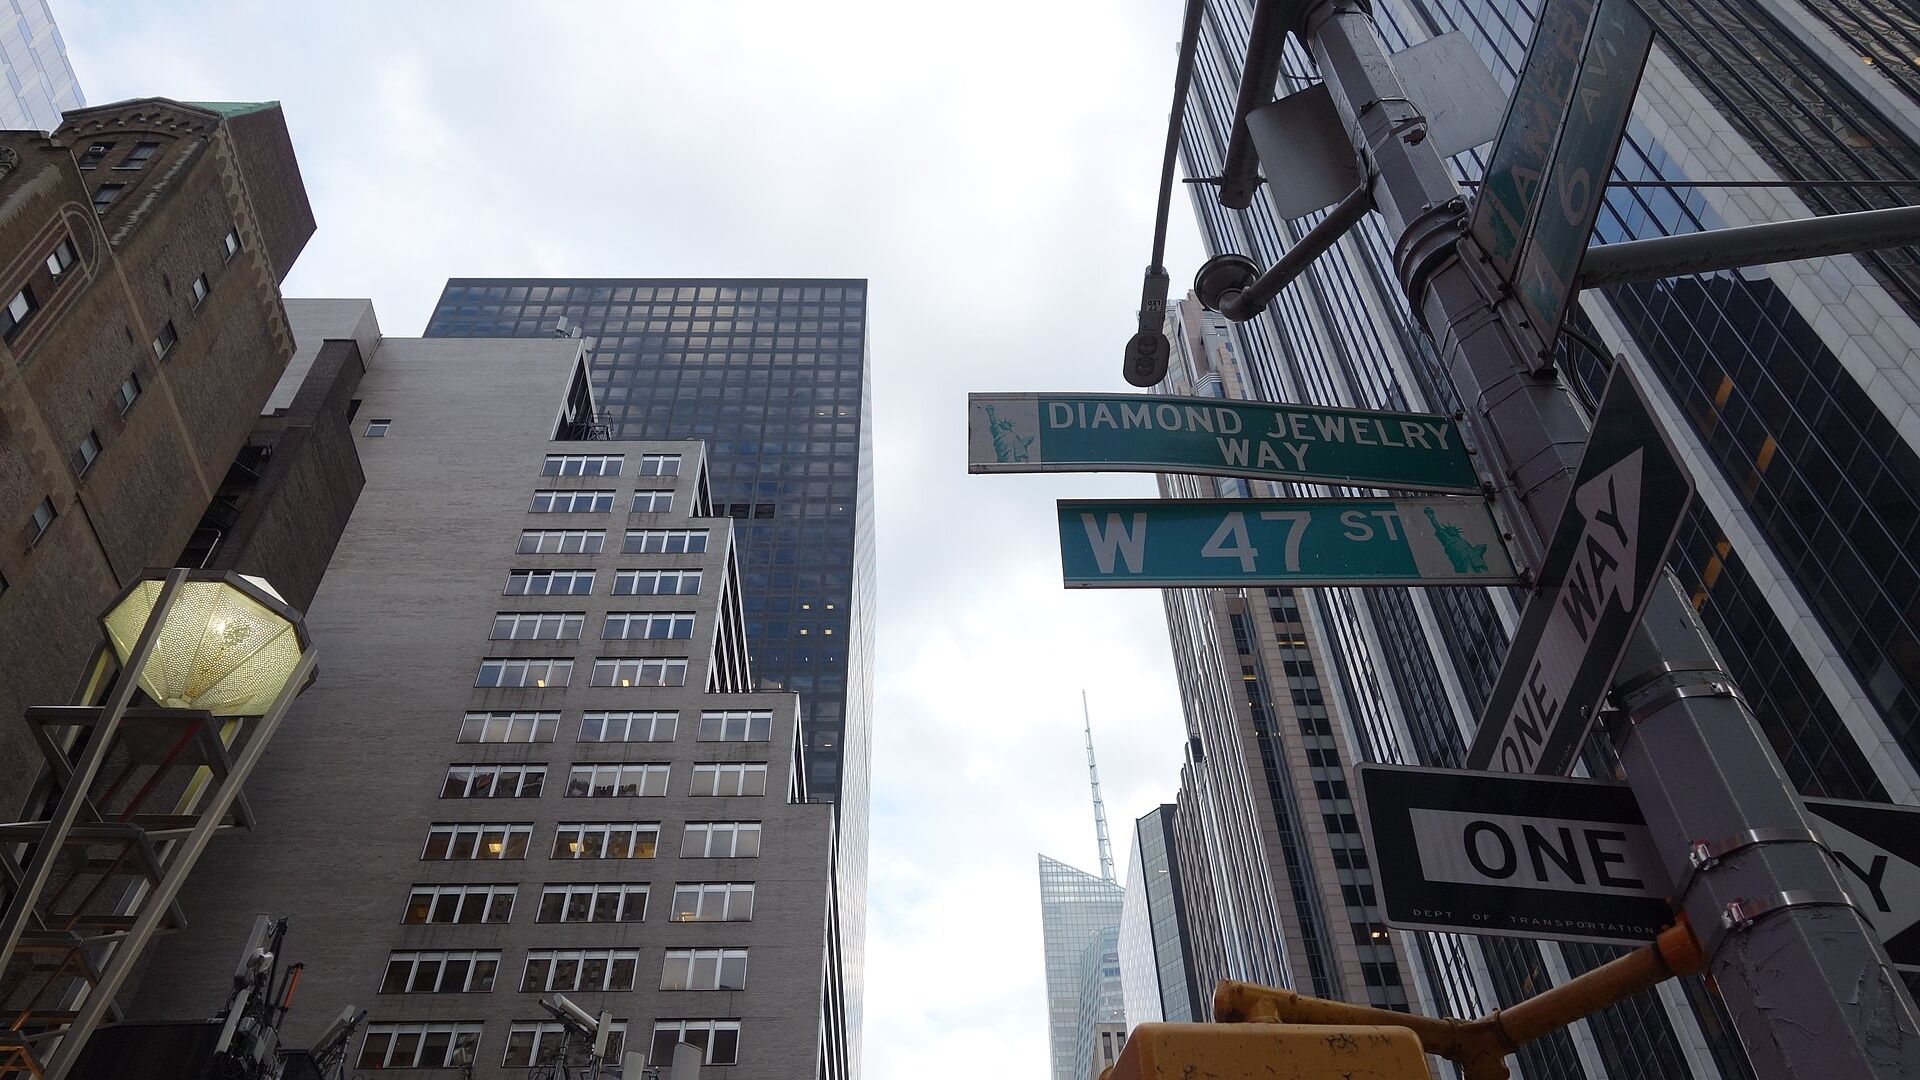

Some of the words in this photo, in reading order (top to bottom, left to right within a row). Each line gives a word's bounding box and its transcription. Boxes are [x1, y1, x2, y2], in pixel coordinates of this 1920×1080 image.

[1558, 162, 1591, 226] 6
[1048, 402, 1242, 435] DIAMOND
[1267, 413, 1450, 451] JEWELRY
[1215, 436, 1310, 472] WAY
[1080, 512, 1148, 574] W
[1200, 511, 1312, 573] 47
[1340, 510, 1402, 543] ST
[1561, 474, 1629, 645] WAY
[1463, 820, 1645, 889] ONE
[1413, 908, 1453, 918] DEPT
[1472, 913, 1490, 921] OF
[1510, 915, 1654, 935] TRANSPORTATION
